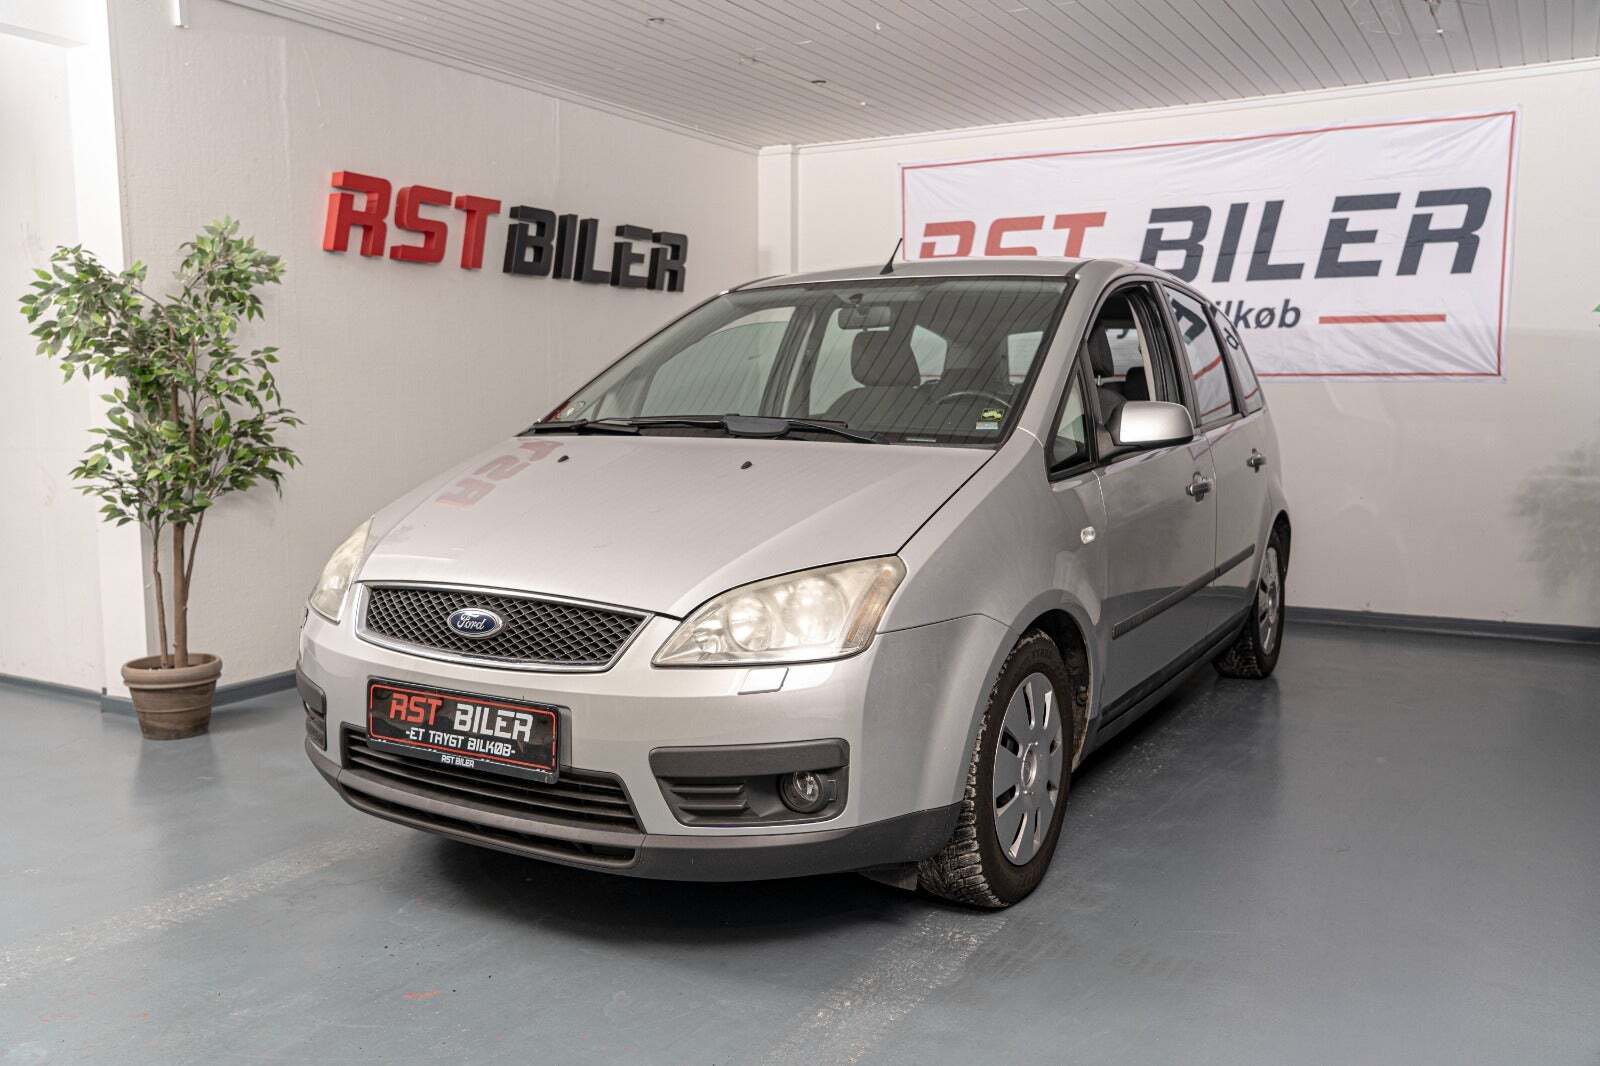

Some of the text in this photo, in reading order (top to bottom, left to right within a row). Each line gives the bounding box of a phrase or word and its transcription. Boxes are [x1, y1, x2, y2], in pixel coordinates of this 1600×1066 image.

[323, 171, 688, 292] RST BILER
[1139, 187, 1491, 283] BILER
[457, 612, 486, 631] Ford
[389, 692, 534, 742] RST BILER
[429, 730, 464, 748] TRYGT
[441, 754, 475, 768] RST BILER
